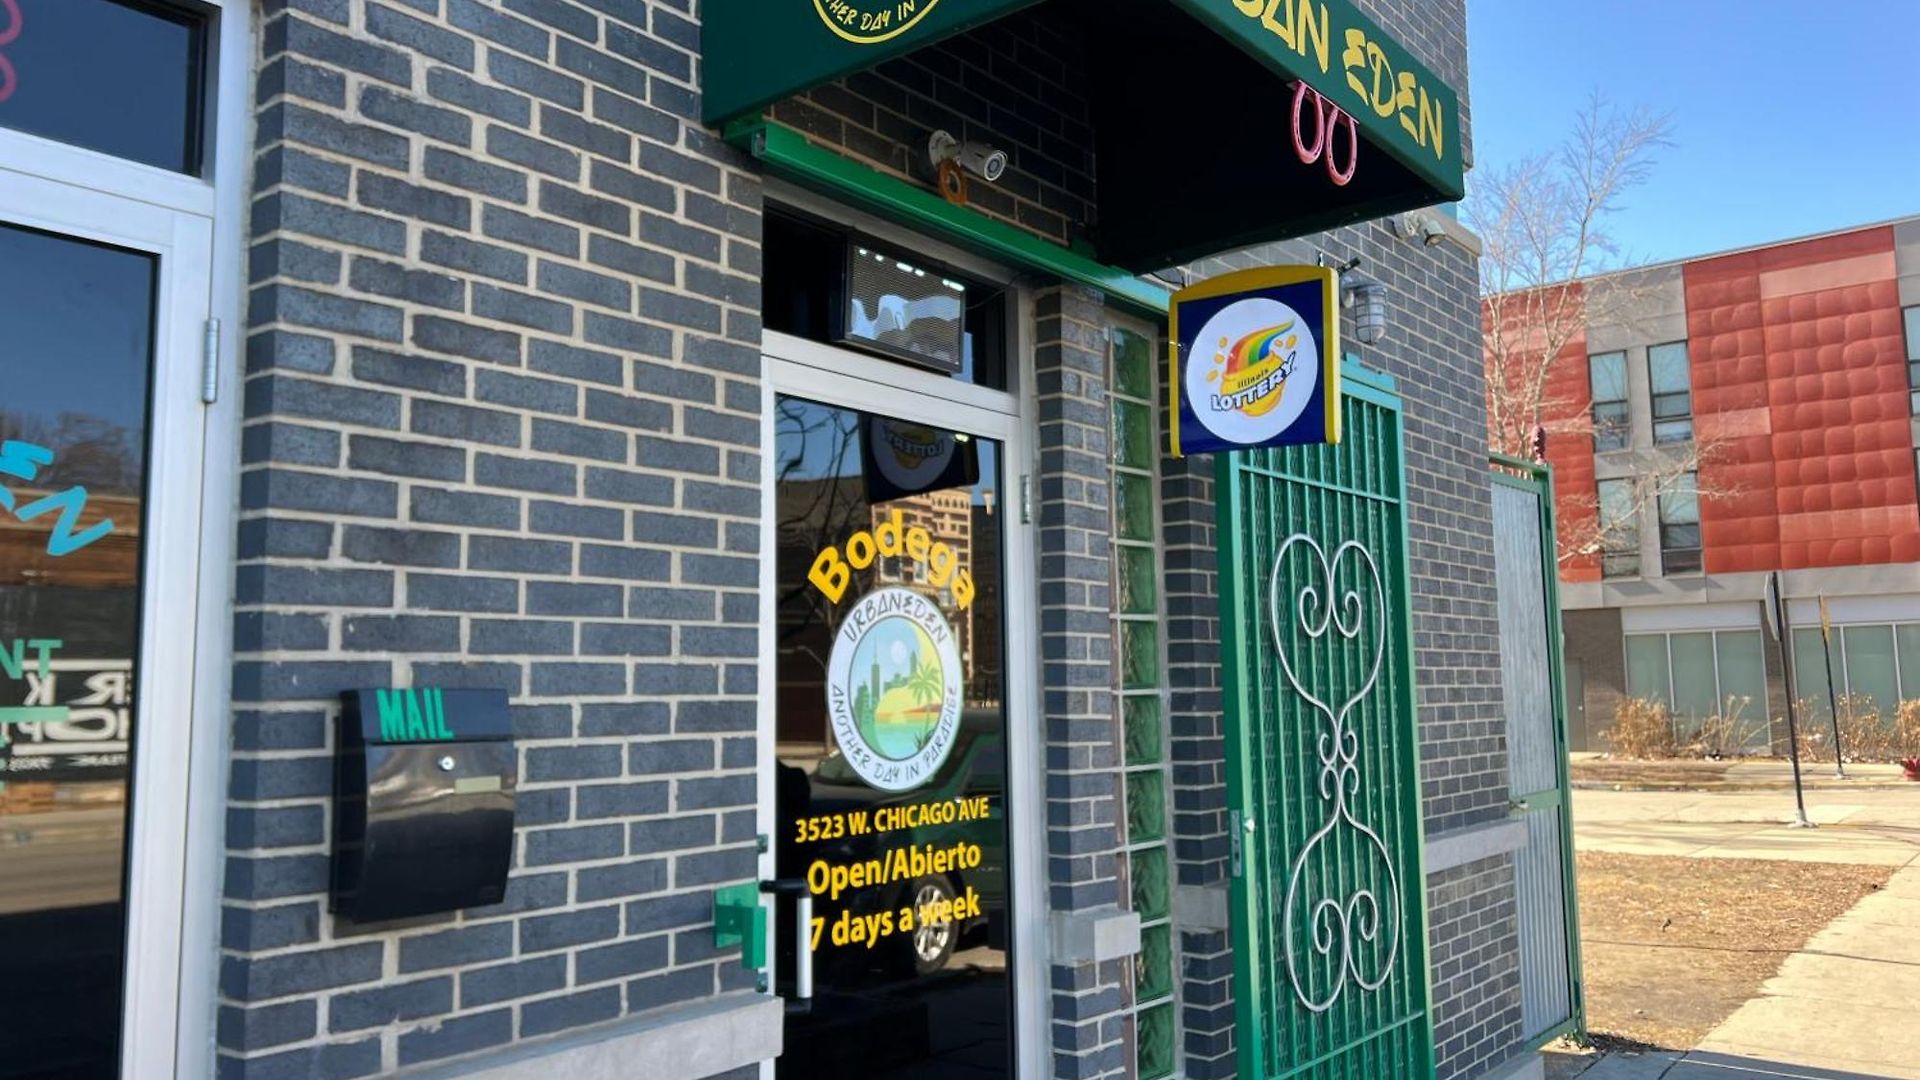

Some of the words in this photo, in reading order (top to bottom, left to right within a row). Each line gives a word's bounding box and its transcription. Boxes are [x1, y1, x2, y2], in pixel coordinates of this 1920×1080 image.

[860, 10, 891, 31] DAY
[897, 0, 916, 21] IN
[1342, 28, 1443, 161] EDEN
[1211, 350, 1296, 412] LOTTERY
[807, 508, 975, 610] Bodega
[376, 687, 456, 742] MAIL
[832, 684, 871, 769] ANOTHER
[873, 762, 900, 783] DAY
[905, 761, 920, 779] IN
[922, 687, 957, 768] PARADISE
[795, 813, 844, 843] 3523
[848, 811, 871, 836] W.
[874, 801, 955, 832] CHICAGO
[958, 796, 990, 821] AVE
[807, 842, 981, 900] Open/Abierto
[808, 917, 825, 951] 7
[831, 910, 893, 949] days
[899, 906, 914, 932] a
[918, 886, 981, 927] week
